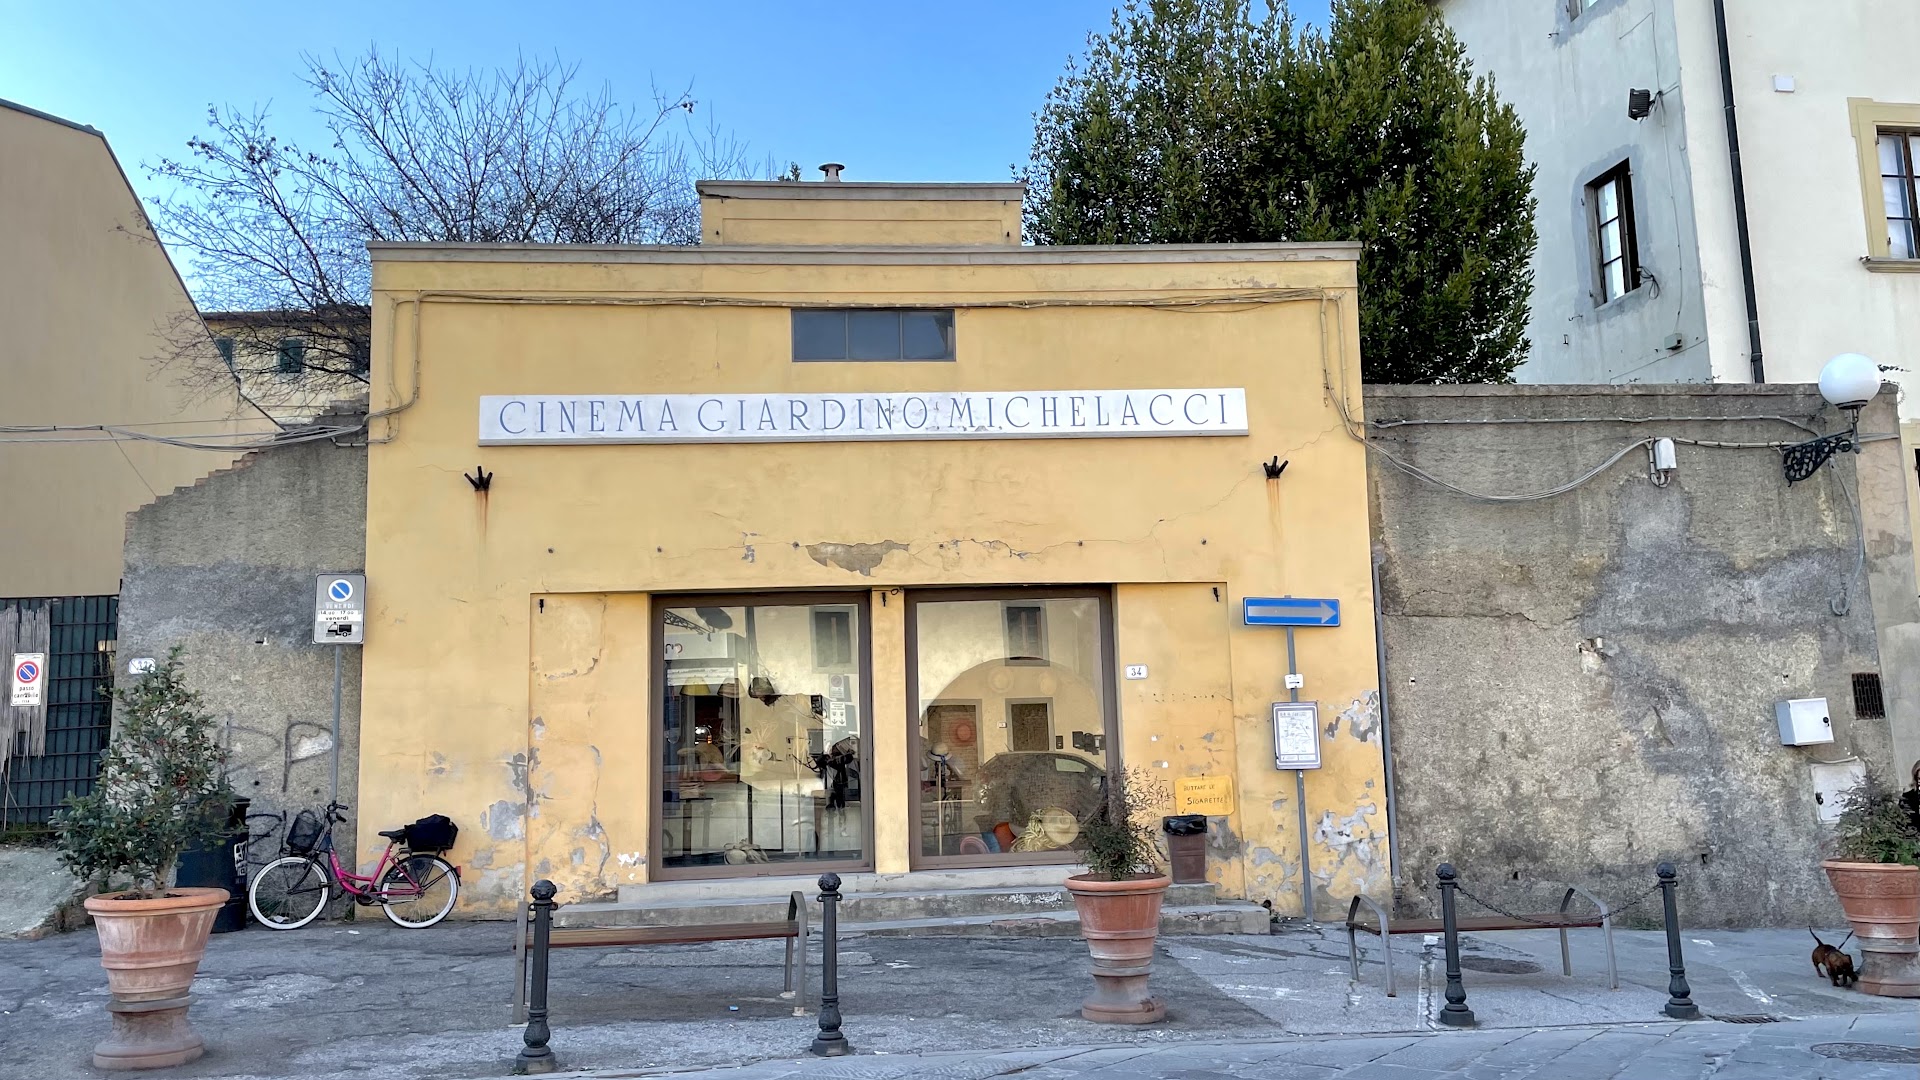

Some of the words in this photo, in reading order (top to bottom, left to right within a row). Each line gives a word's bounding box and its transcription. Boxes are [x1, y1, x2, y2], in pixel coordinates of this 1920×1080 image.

[499, 400, 679, 434] CINEMA
[697, 397, 928, 432] GIARDINO
[949, 393, 1229, 428] MICHELACCI
[1131, 667, 1142, 676] 34
[1186, 796, 1224, 805] SIGARETTE
